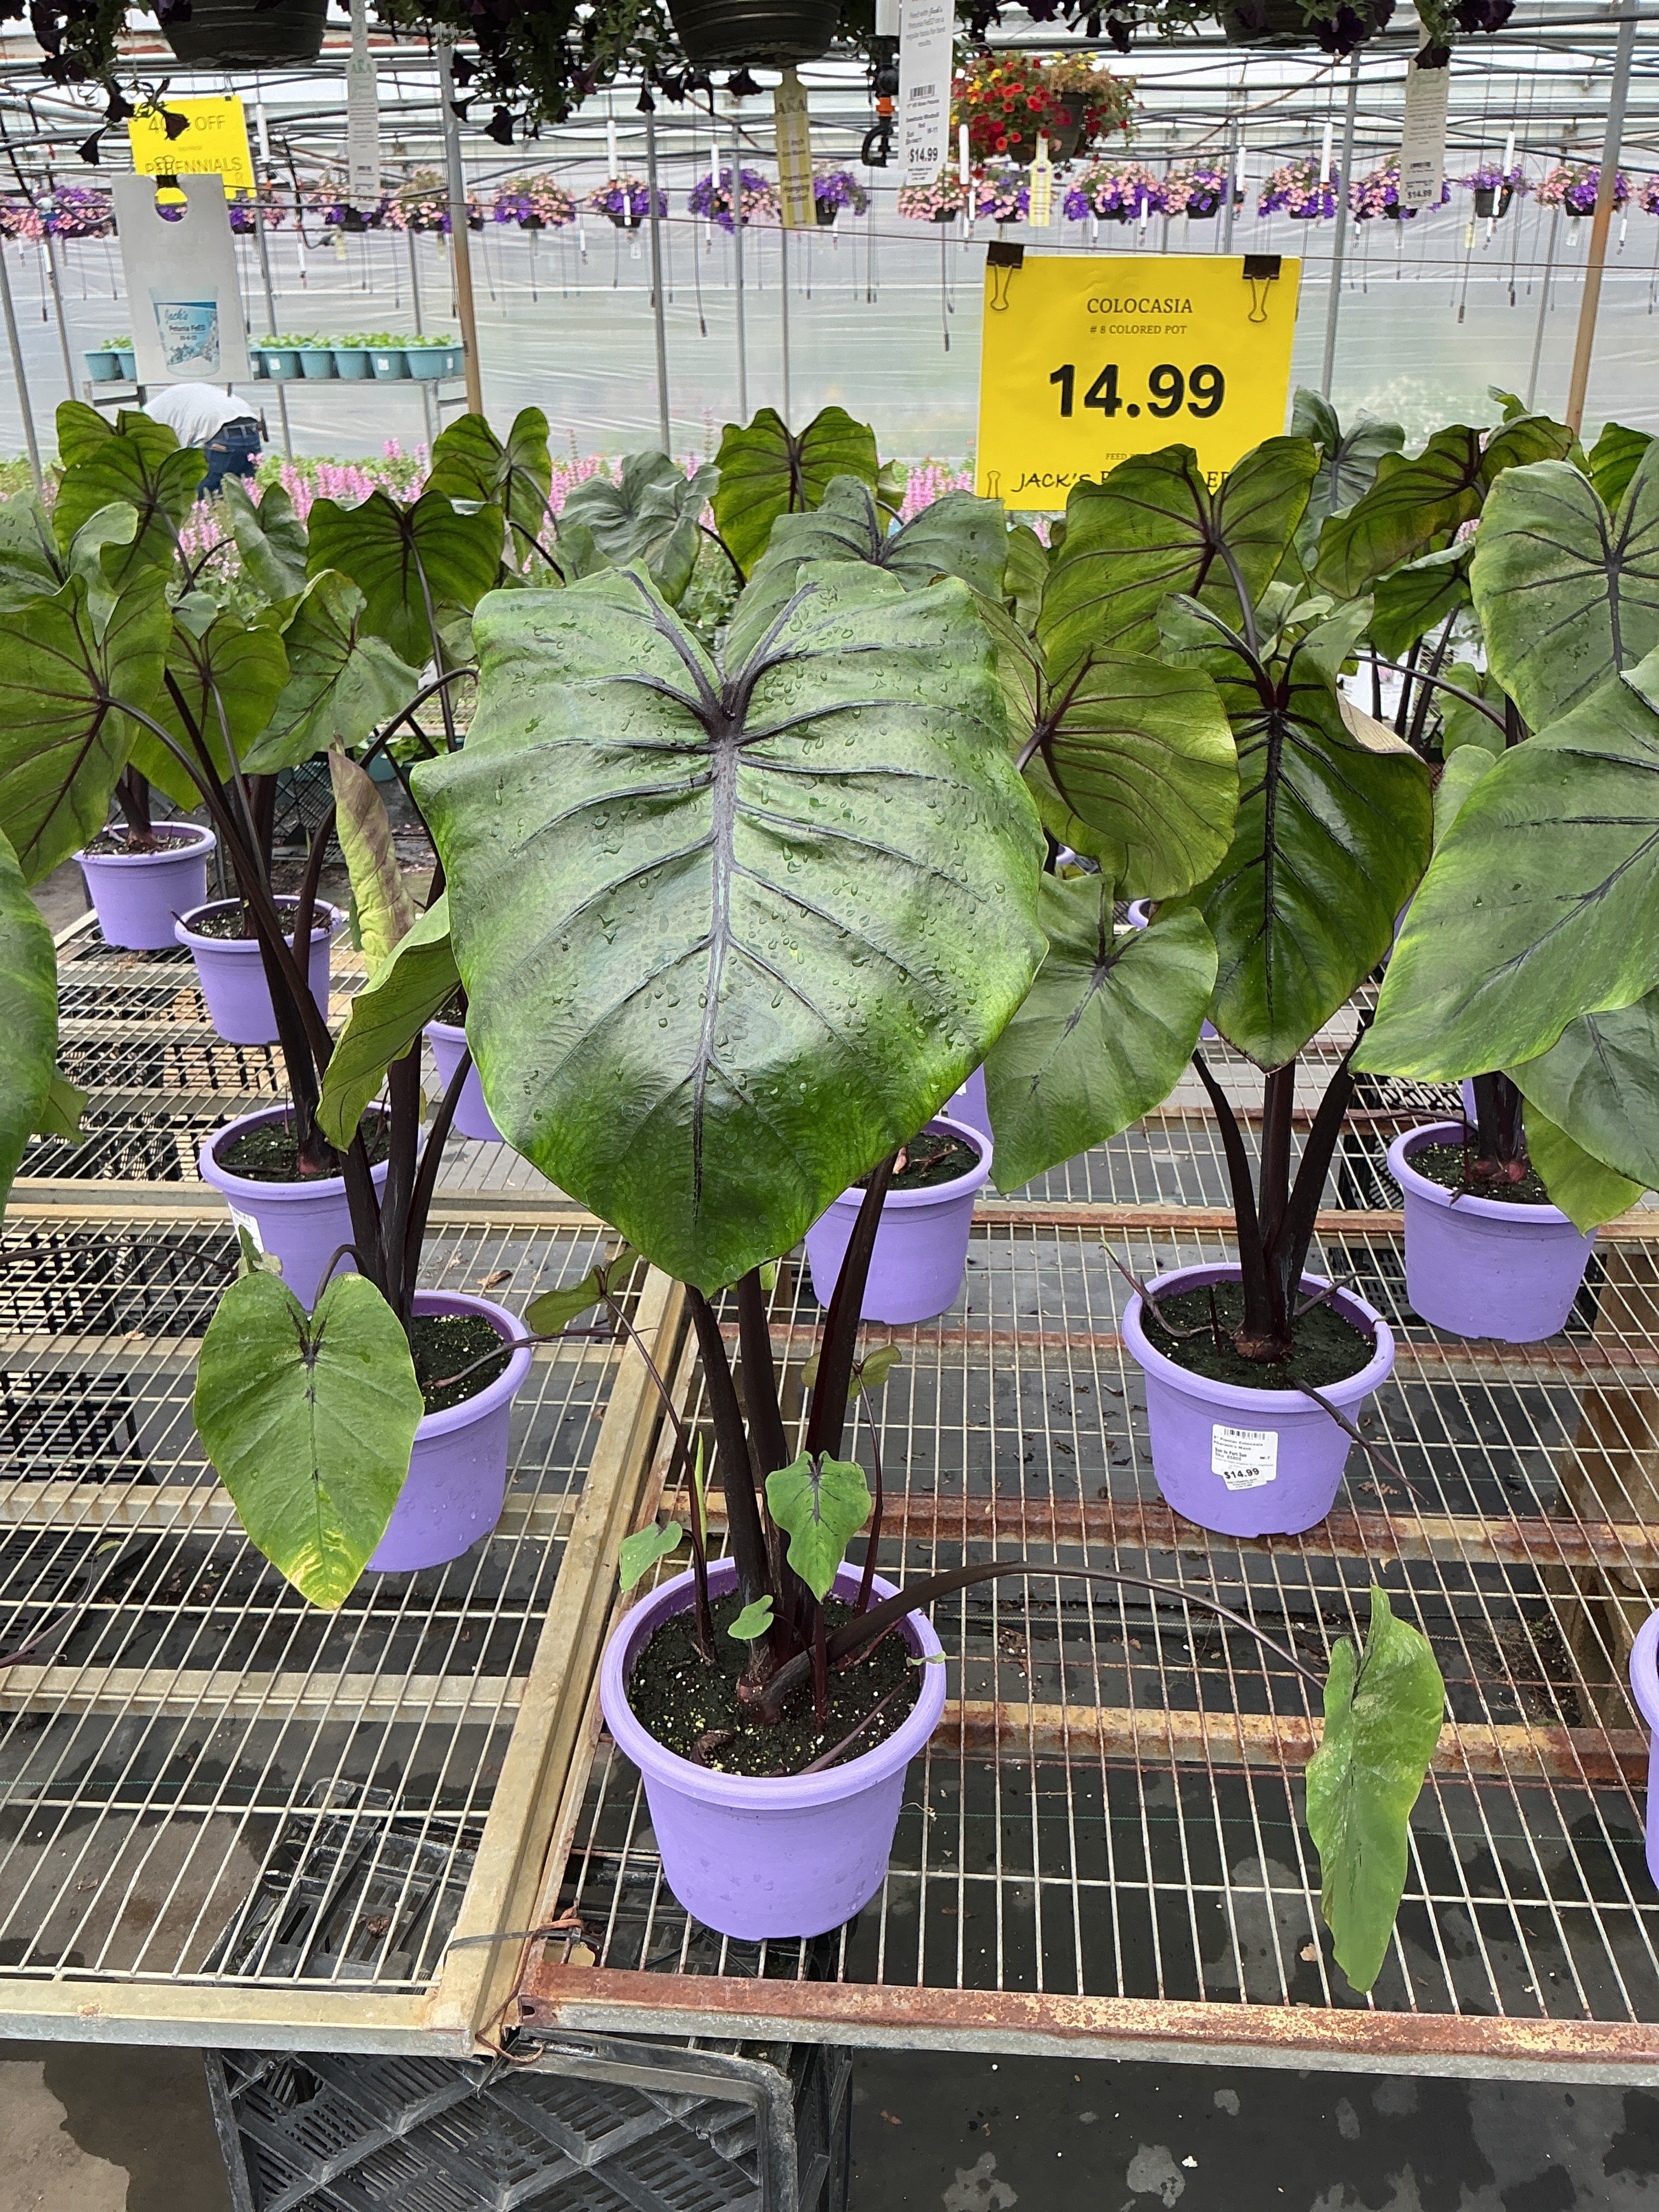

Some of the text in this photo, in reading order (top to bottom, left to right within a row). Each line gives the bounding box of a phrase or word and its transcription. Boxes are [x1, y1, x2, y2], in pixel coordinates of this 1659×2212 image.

[195, 114, 226, 131] OFF
[910, 147, 938, 163] $14.99
[1087, 298, 1193, 313] COLOCASIA
[1108, 325, 1161, 334] COLORED
[1164, 325, 1188, 334] POT
[1049, 363, 1225, 418] 14.99
[1224, 1468, 1260, 1480] $14.99
